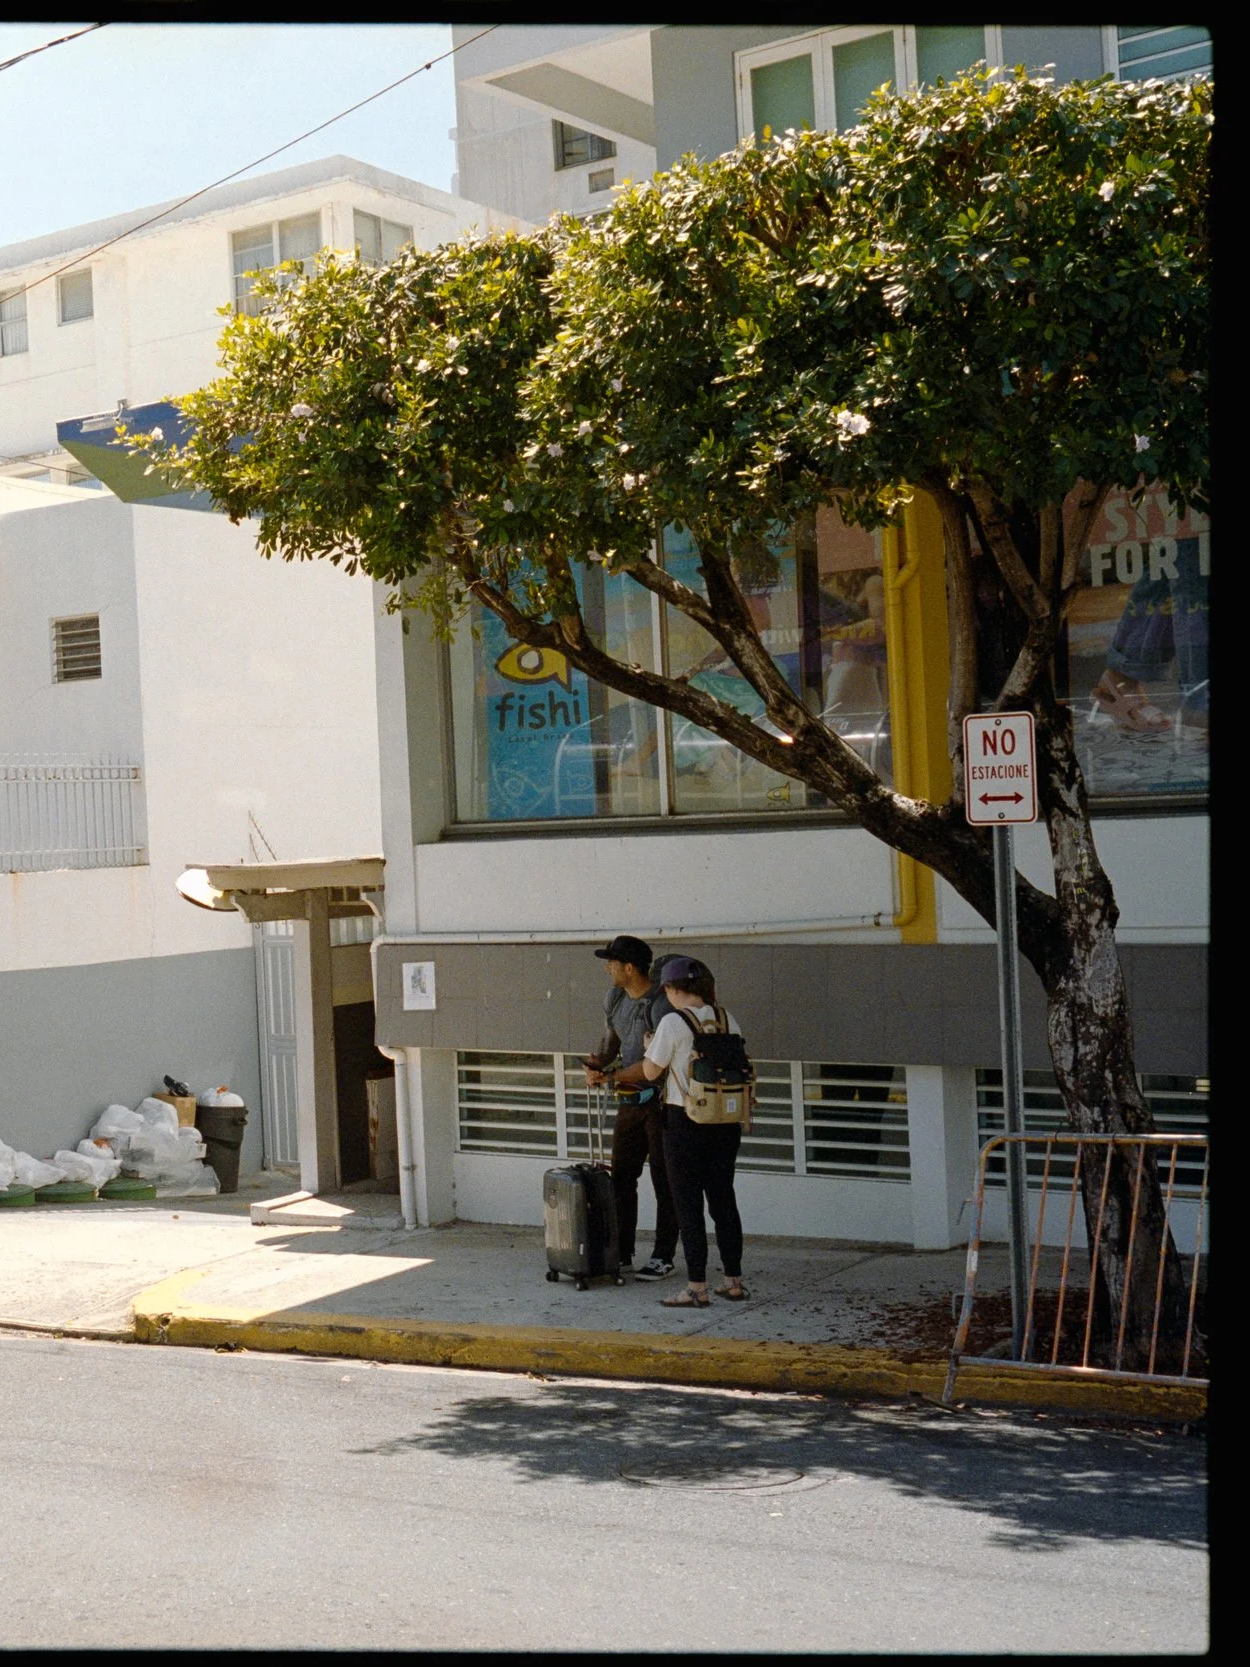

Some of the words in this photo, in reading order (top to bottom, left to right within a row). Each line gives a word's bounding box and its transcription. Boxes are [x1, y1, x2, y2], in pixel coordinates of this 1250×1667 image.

[1090, 536, 1179, 587] FOR
[495, 689, 581, 731] fishi
[982, 728, 1016, 756] NO
[971, 764, 1029, 780] ESTACIONE
